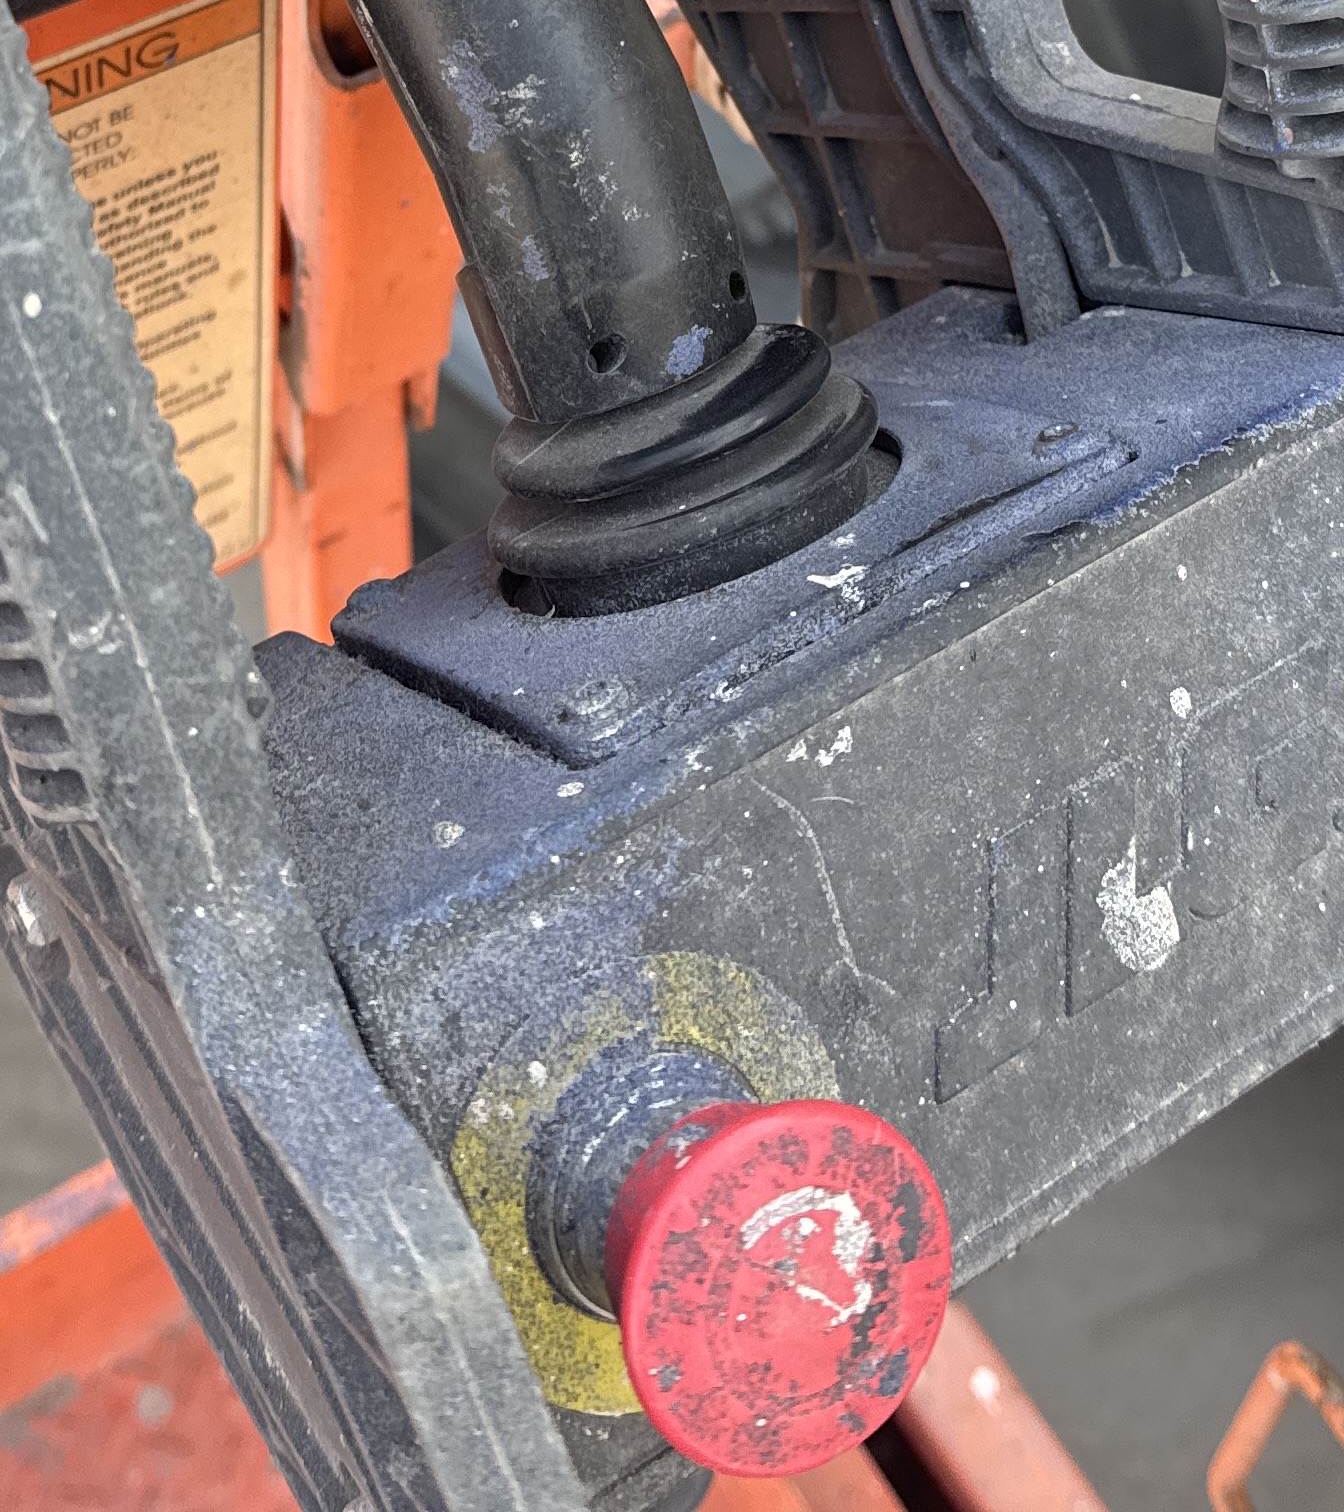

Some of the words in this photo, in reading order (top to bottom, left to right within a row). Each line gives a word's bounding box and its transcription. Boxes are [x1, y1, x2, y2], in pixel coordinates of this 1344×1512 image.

[45, 31, 179, 107] NING
[109, 104, 134, 126] BE
[113, 167, 176, 201] unless
[183, 150, 217, 175] you
[97, 213, 142, 239] afety
[149, 180, 215, 215] Manual
